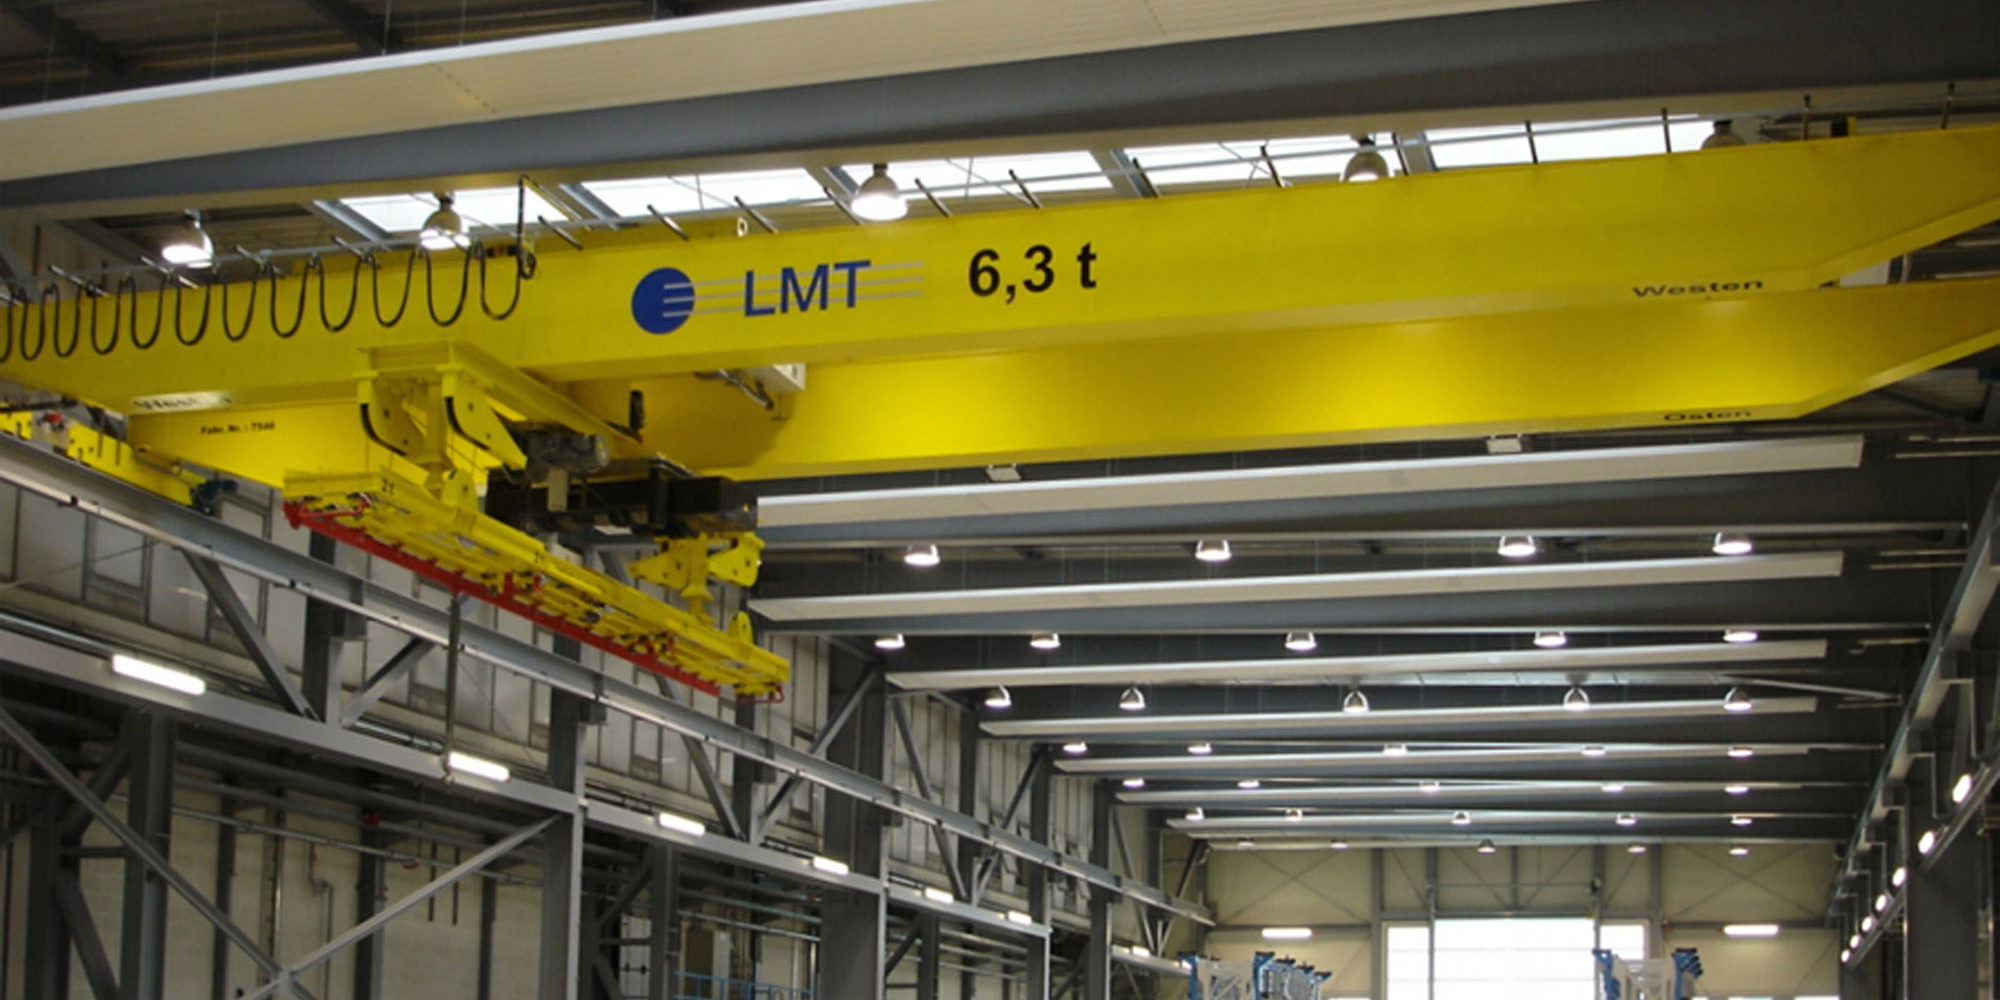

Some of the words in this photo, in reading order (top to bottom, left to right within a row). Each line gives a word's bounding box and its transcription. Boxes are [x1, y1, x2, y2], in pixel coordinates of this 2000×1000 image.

[744, 259, 871, 317] LMT
[968, 243, 1055, 305] 6,3
[1076, 241, 1098, 289] t
[1632, 280, 1764, 298] Westen
[1664, 410, 1752, 422] Osten
